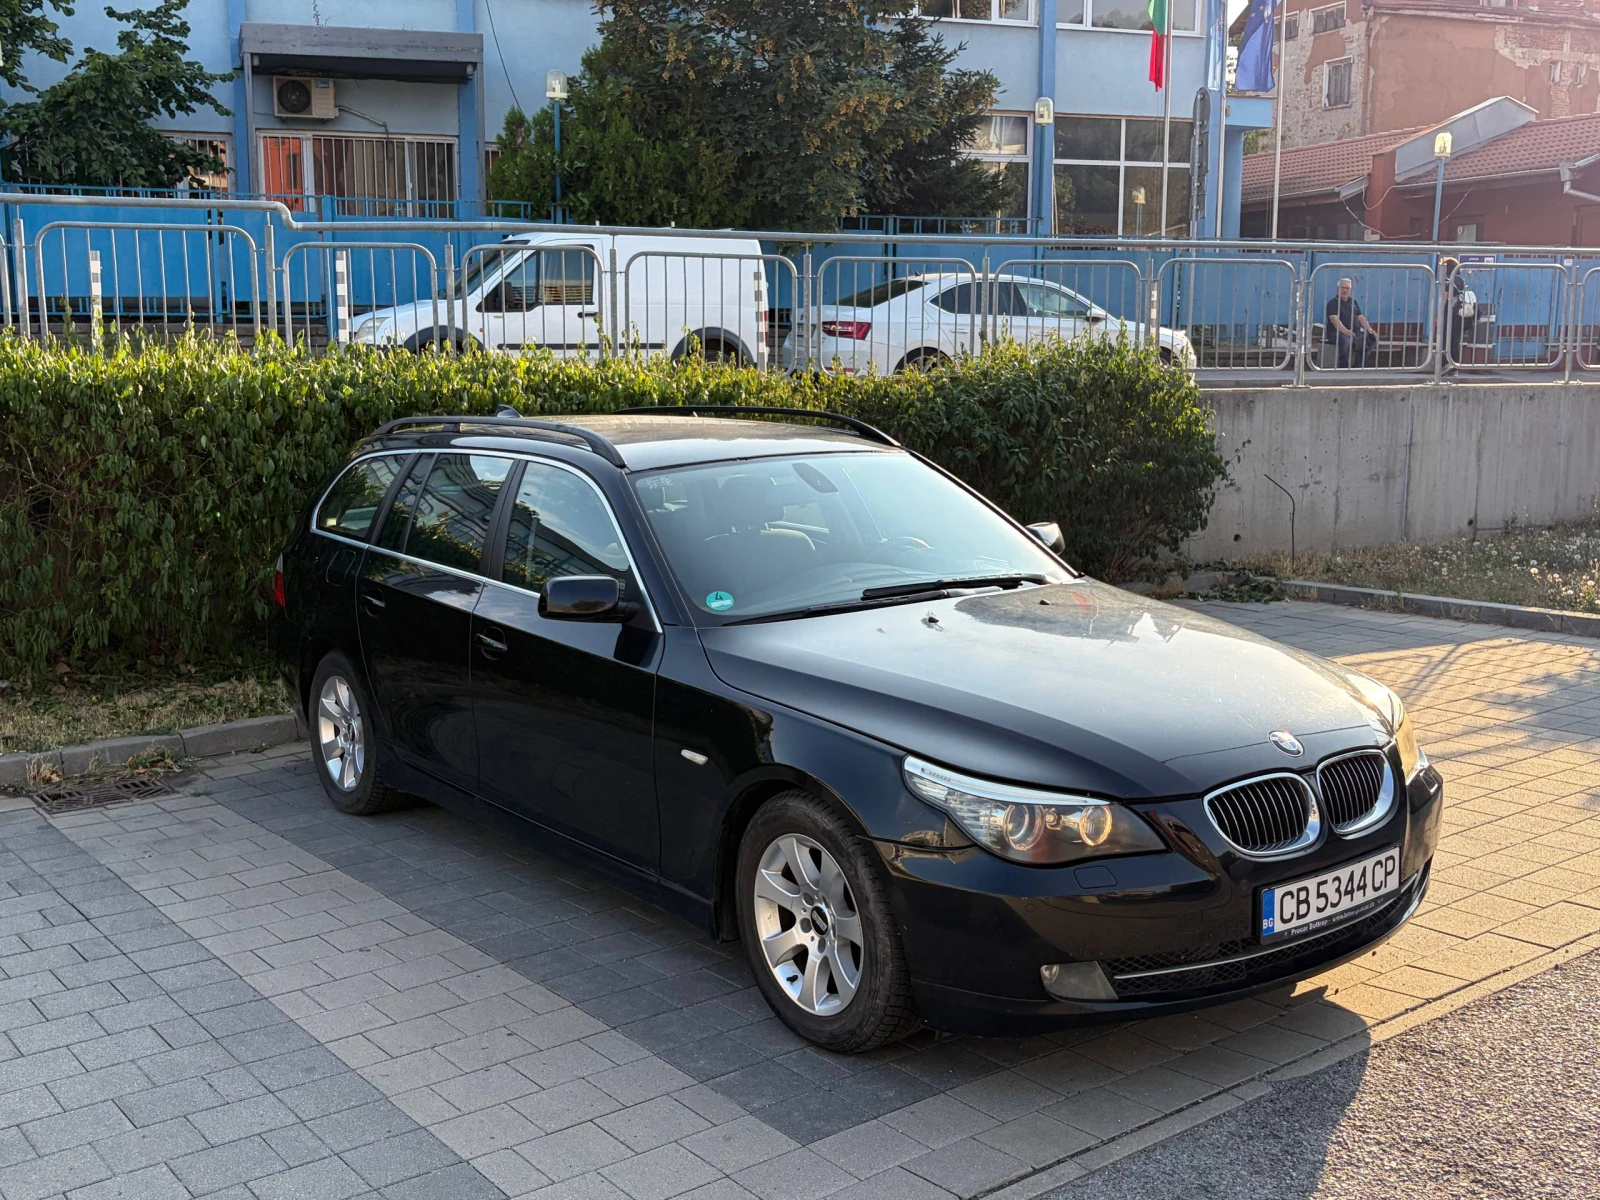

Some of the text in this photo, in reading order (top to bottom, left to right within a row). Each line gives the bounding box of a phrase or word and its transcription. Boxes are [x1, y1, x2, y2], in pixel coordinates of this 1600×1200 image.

[1279, 854, 1396, 924] CB 5344 CP
[1262, 918, 1274, 930] BG
